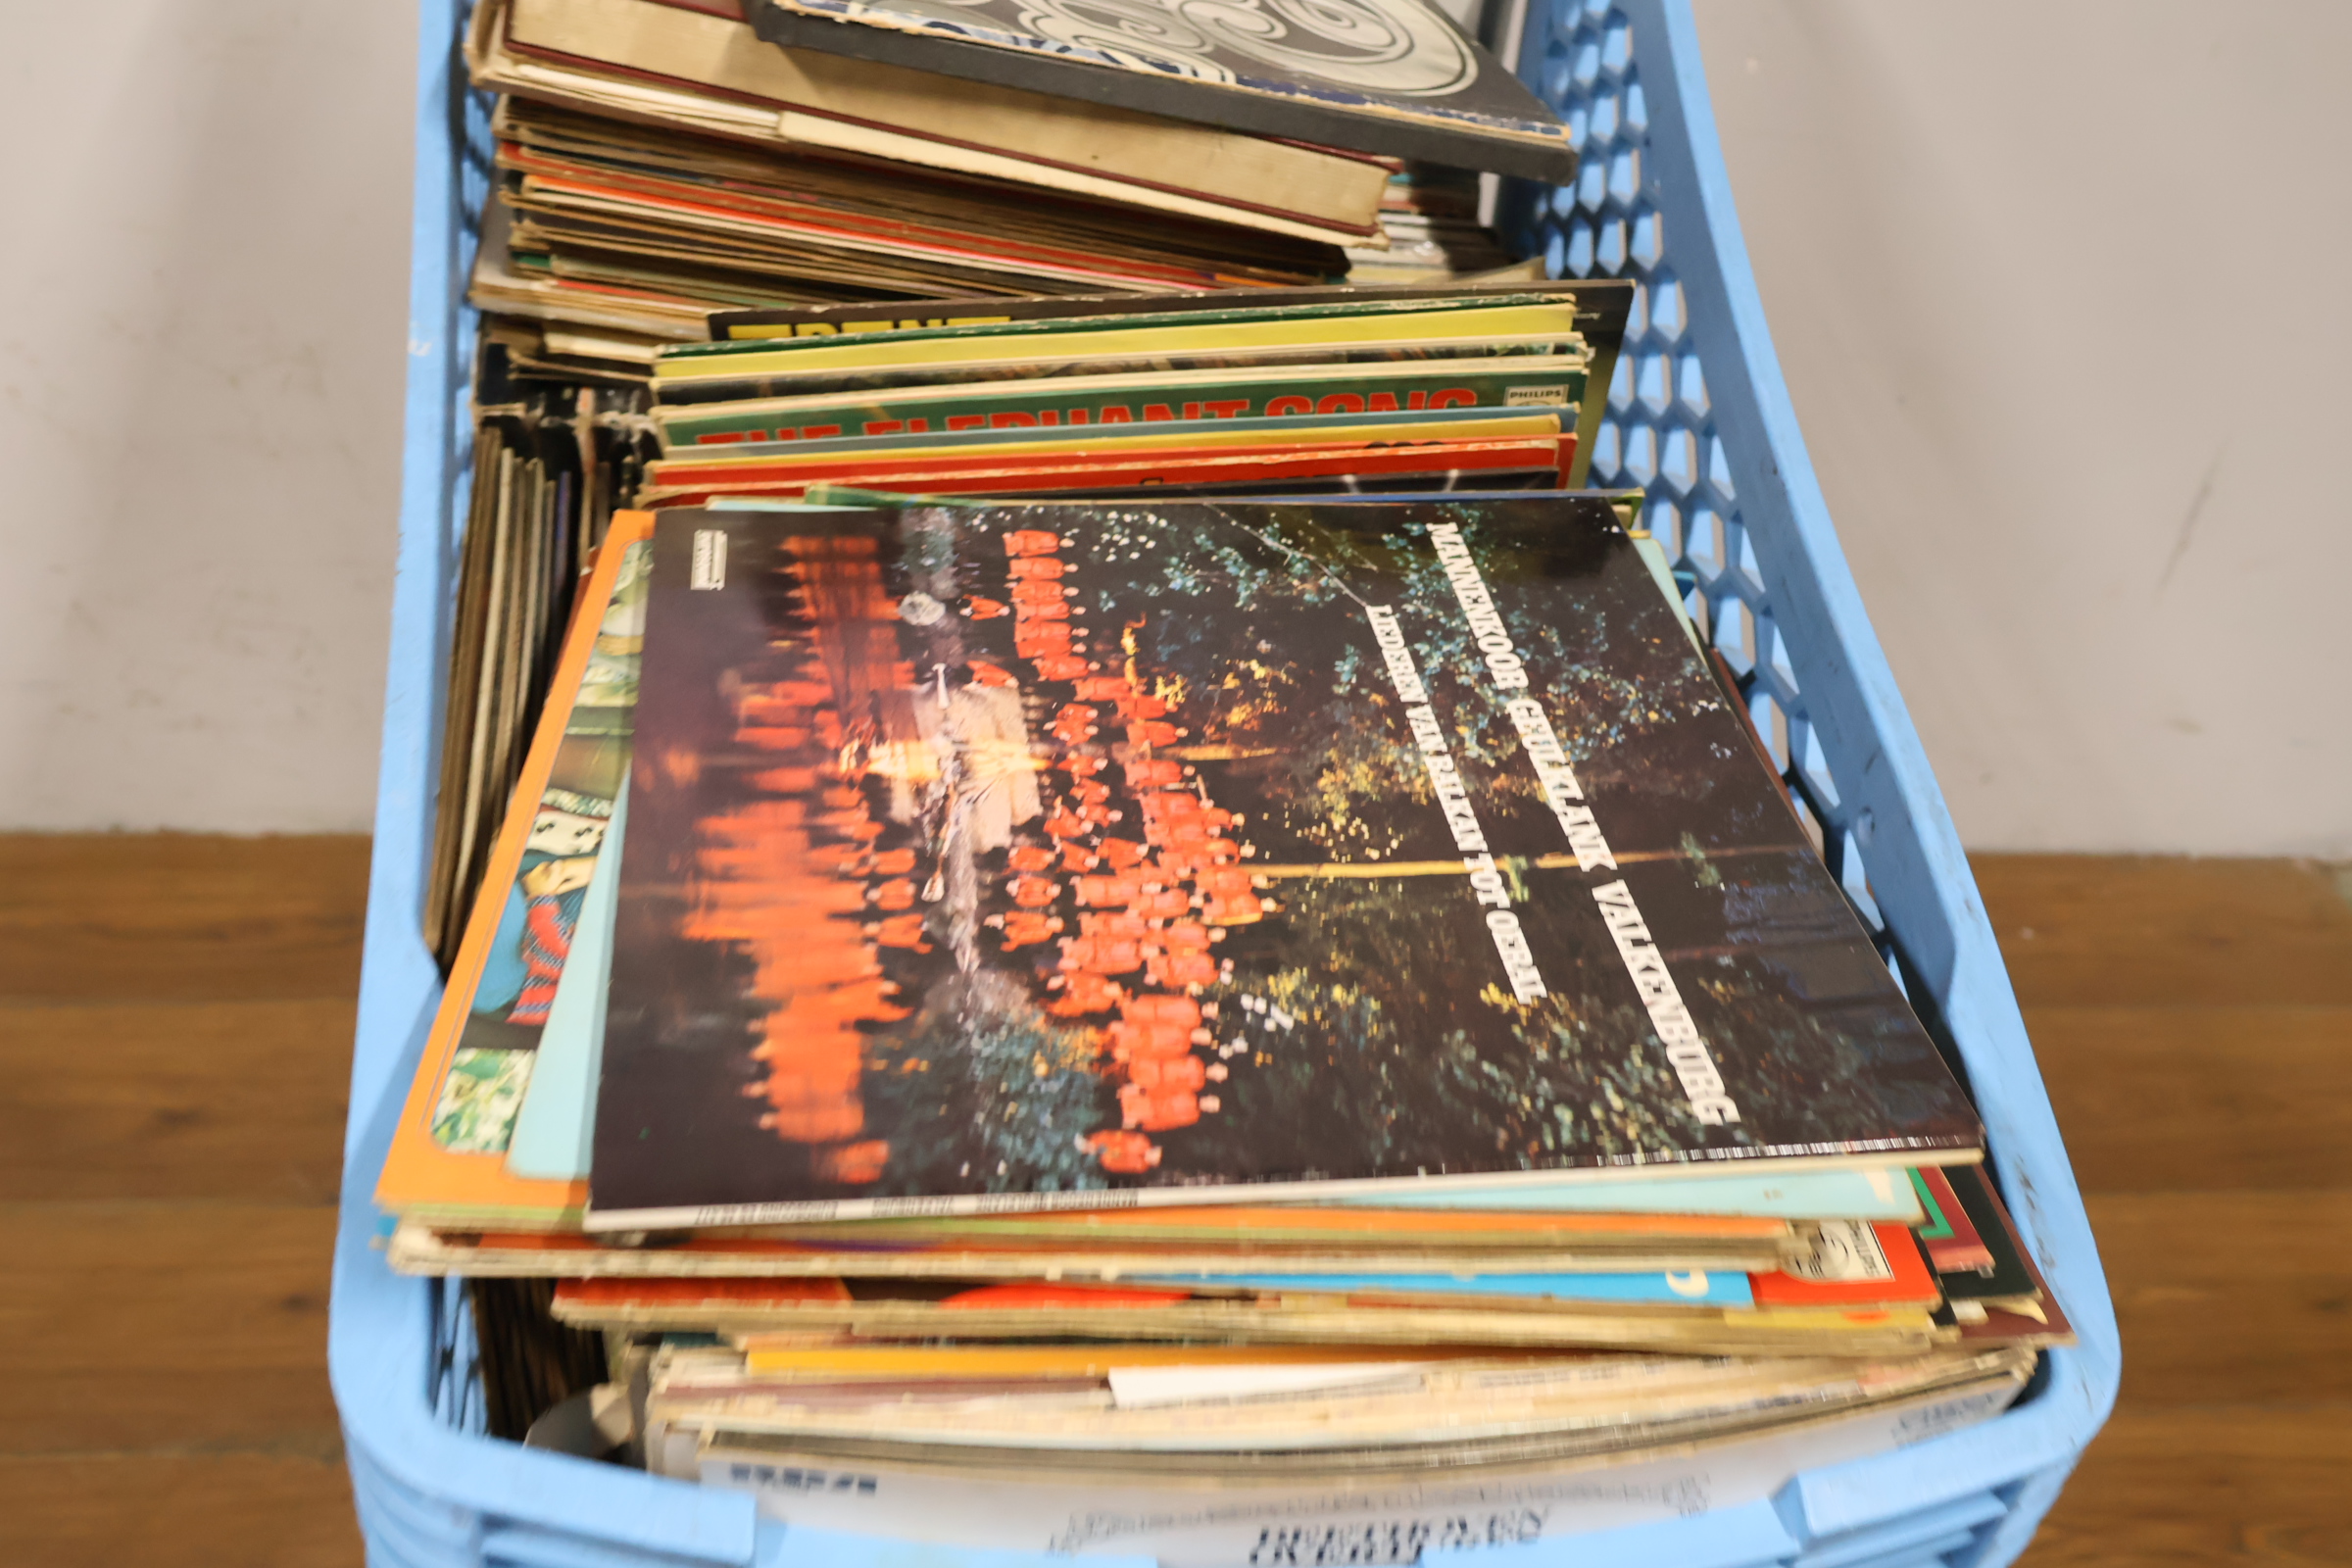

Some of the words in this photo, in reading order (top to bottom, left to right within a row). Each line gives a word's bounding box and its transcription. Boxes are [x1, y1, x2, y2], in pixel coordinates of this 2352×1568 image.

[1509, 389, 1561, 399] PHILIPS
[1365, 604, 1428, 704] LIEDEREN
[1405, 705, 1447, 753] VAN
[1424, 754, 1488, 852] BALKAN
[1425, 521, 1529, 690] MANNENKOOR
[1592, 878, 1741, 1126] VALKENBURG
[1463, 853, 1511, 907] TOT
[1485, 909, 1547, 1004] OERAL
